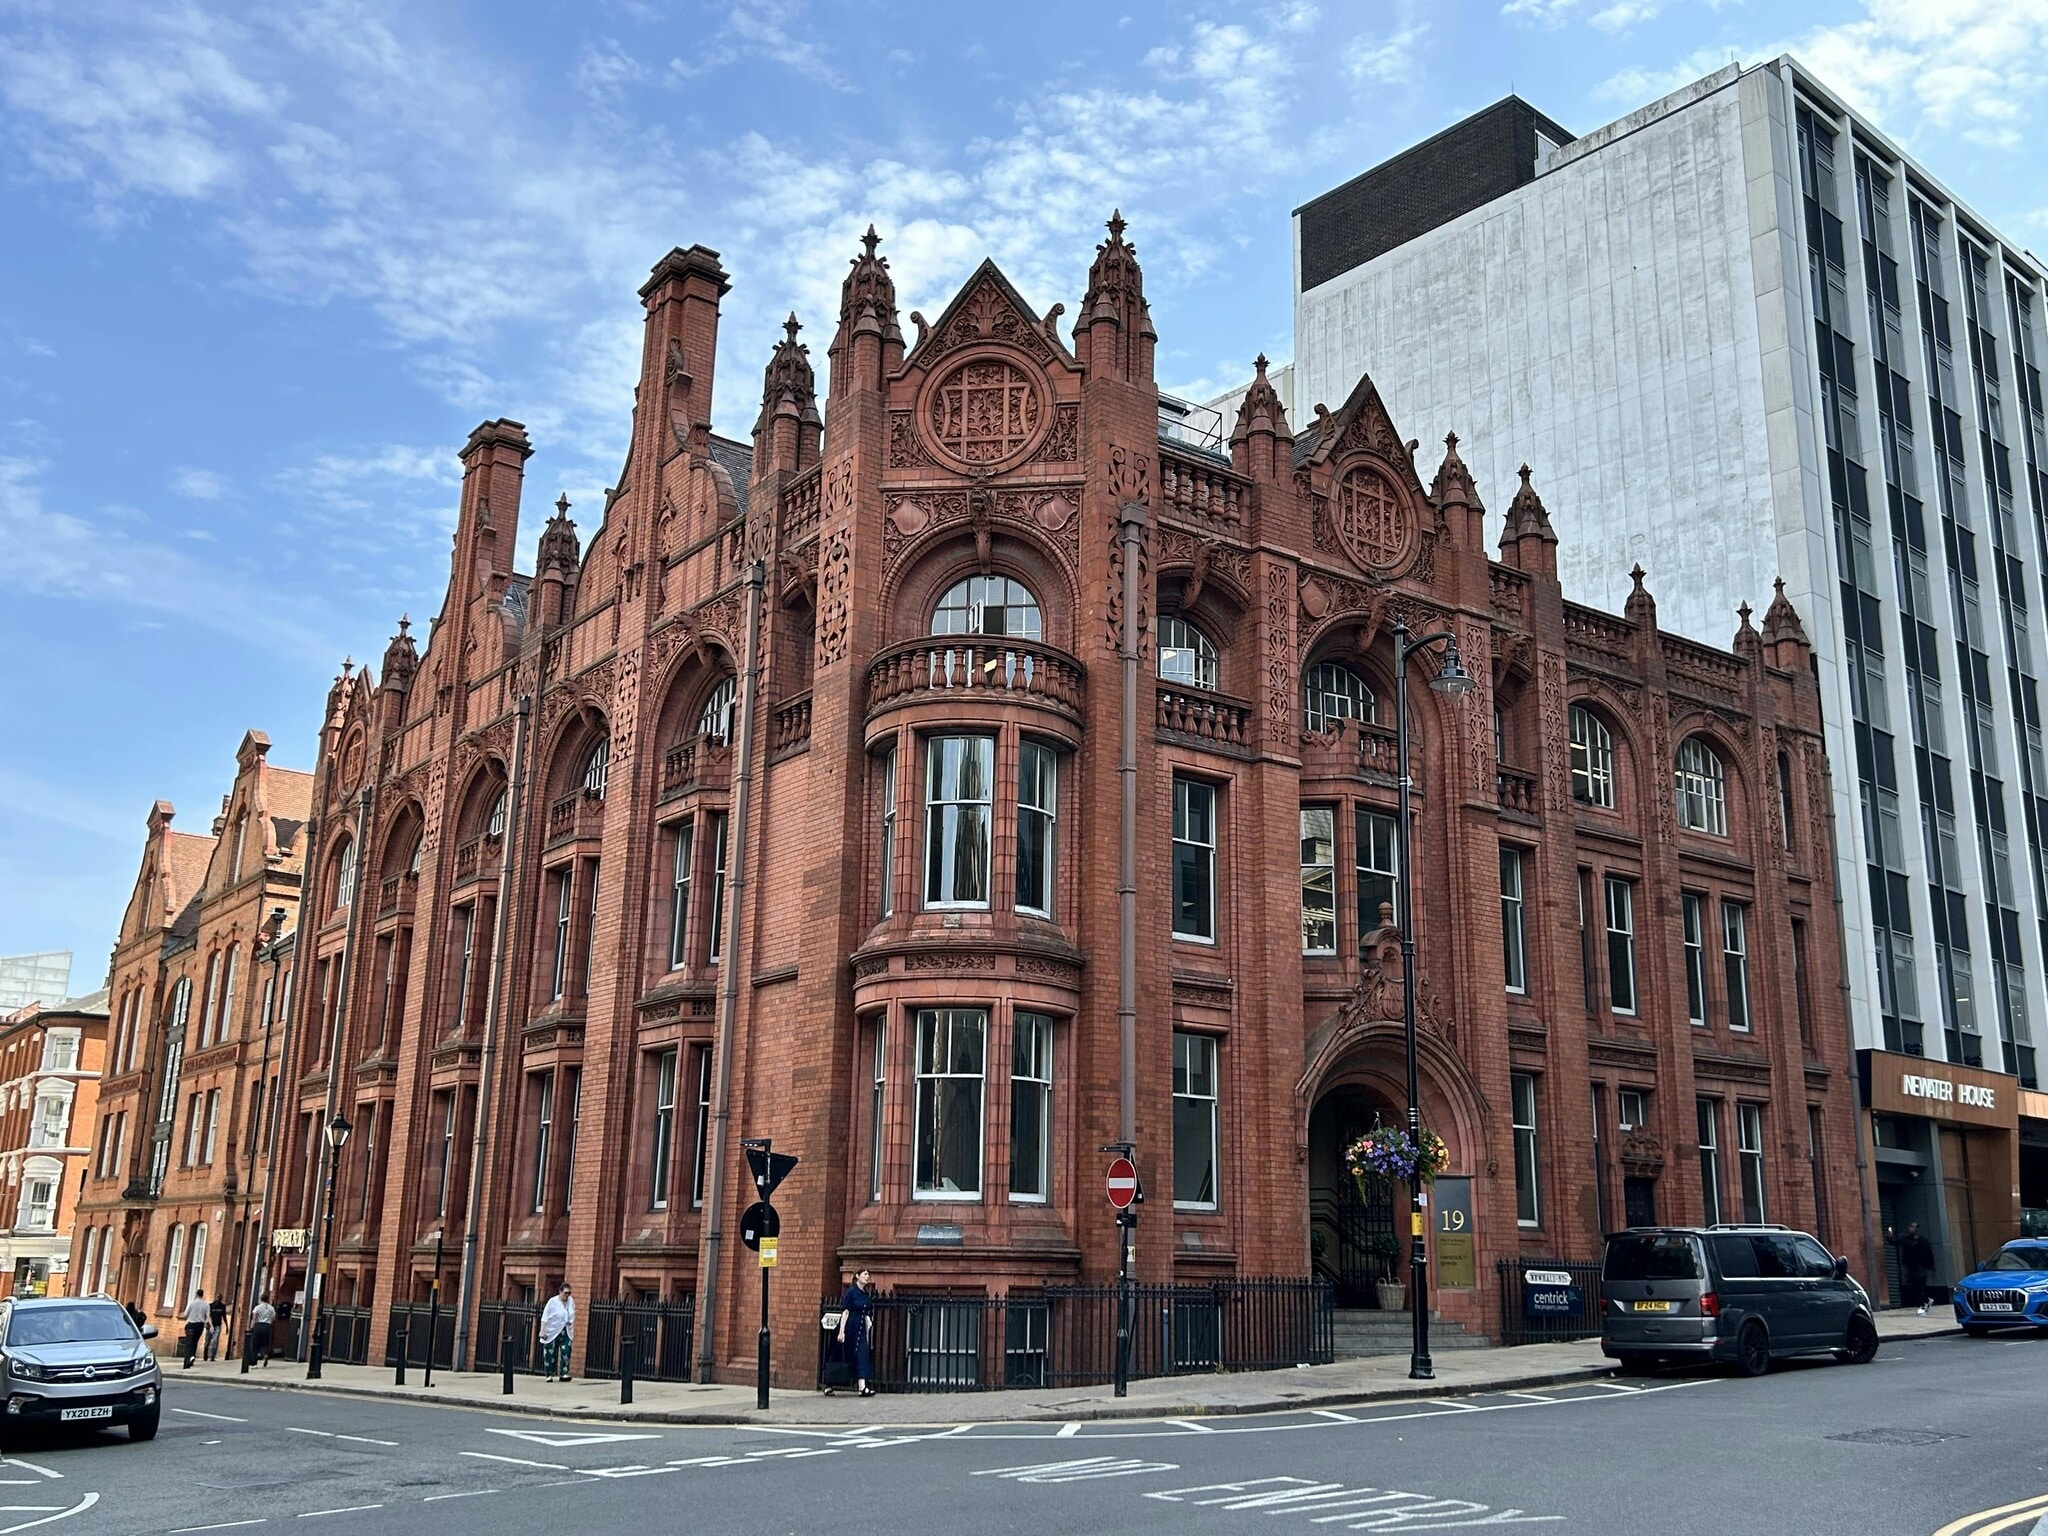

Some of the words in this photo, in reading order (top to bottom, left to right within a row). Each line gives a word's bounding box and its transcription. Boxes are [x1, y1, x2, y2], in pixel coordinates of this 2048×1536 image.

[1903, 1074, 1953, 1102] NEWATER
[1958, 1083, 1995, 1109] HOUSE
[1441, 1209, 1465, 1231] 19
[1533, 1290, 1569, 1305] centrick
[65, 1409, 90, 1419] YX20
[91, 1407, 110, 1417] EZH
[969, 1456, 1180, 1483] NO
[1140, 1476, 1567, 1533] ENTRY
